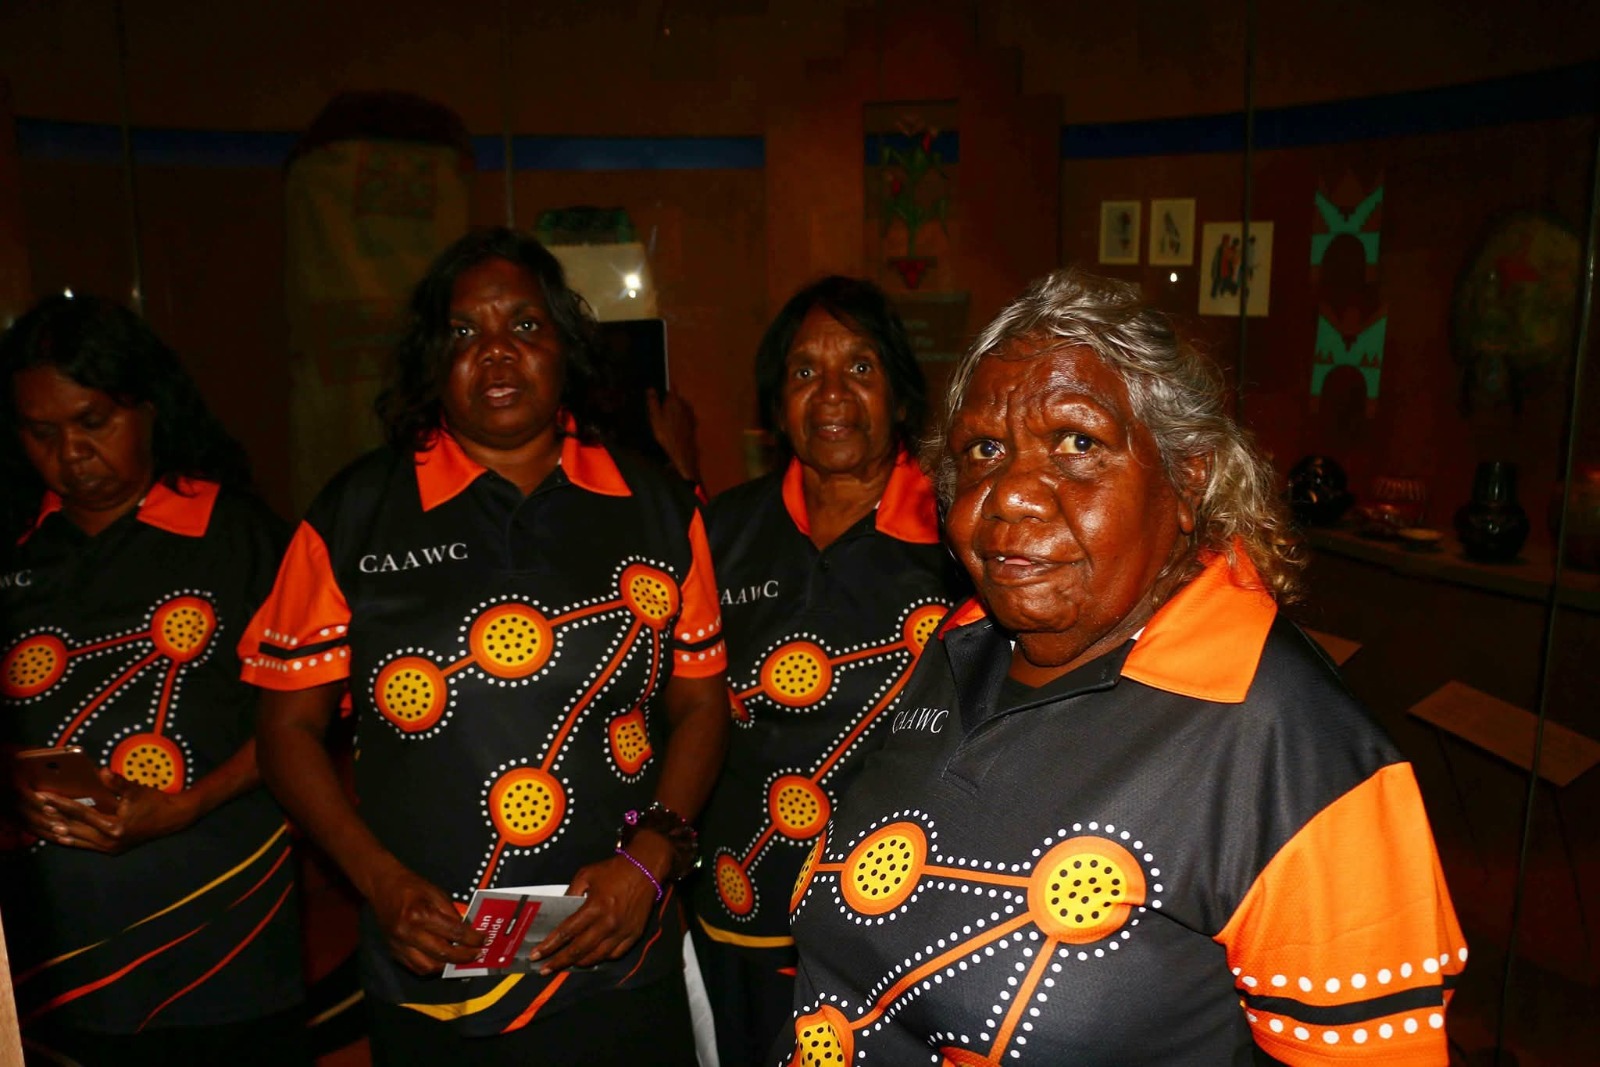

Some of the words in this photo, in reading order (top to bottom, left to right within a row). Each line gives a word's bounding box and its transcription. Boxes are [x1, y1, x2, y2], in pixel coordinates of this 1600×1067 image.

[359, 542, 469, 574] CAAWC
[719, 579, 779, 606] AAWC
[892, 708, 949, 734] CAAWC
[475, 915, 492, 931] lan
